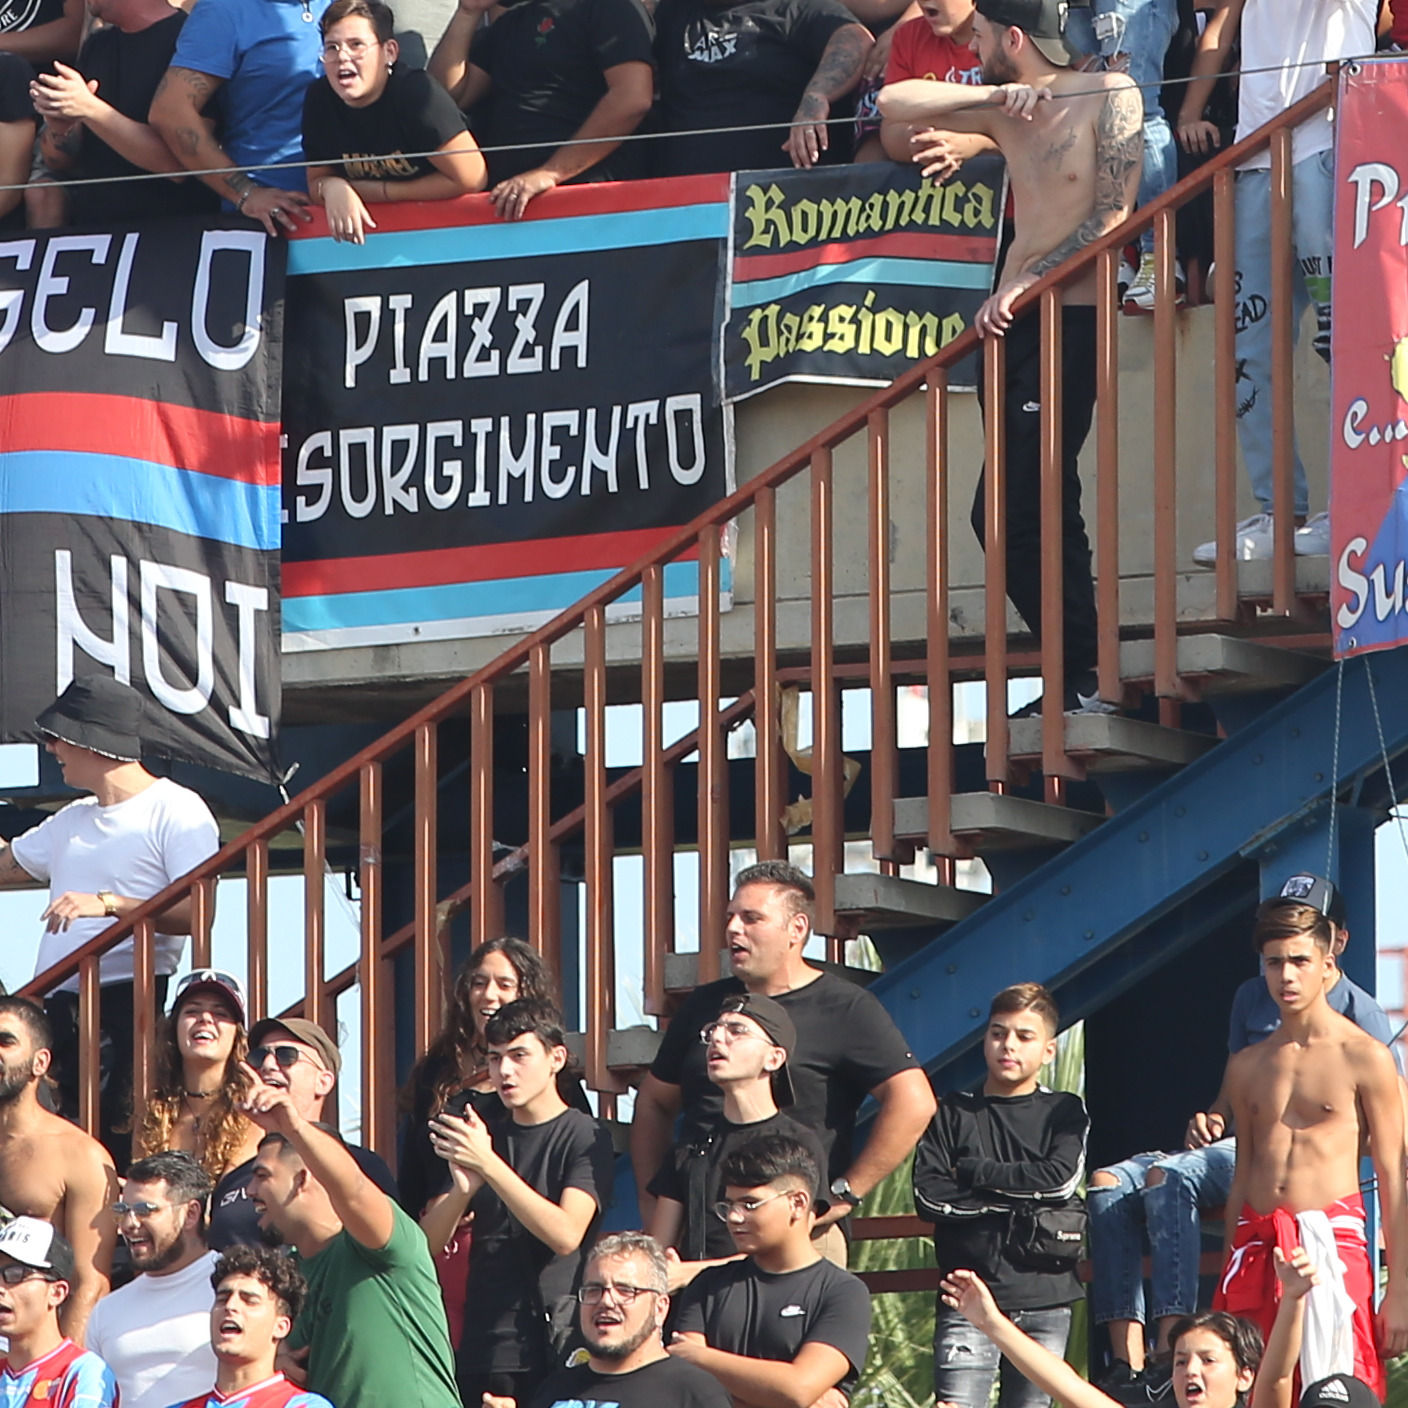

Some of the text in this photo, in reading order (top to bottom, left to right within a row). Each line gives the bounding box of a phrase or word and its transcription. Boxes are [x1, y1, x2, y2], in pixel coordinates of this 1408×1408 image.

[742, 173, 996, 254] Romantica
[343, 278, 590, 389] PIAZZA
[741, 289, 966, 381] Passione
